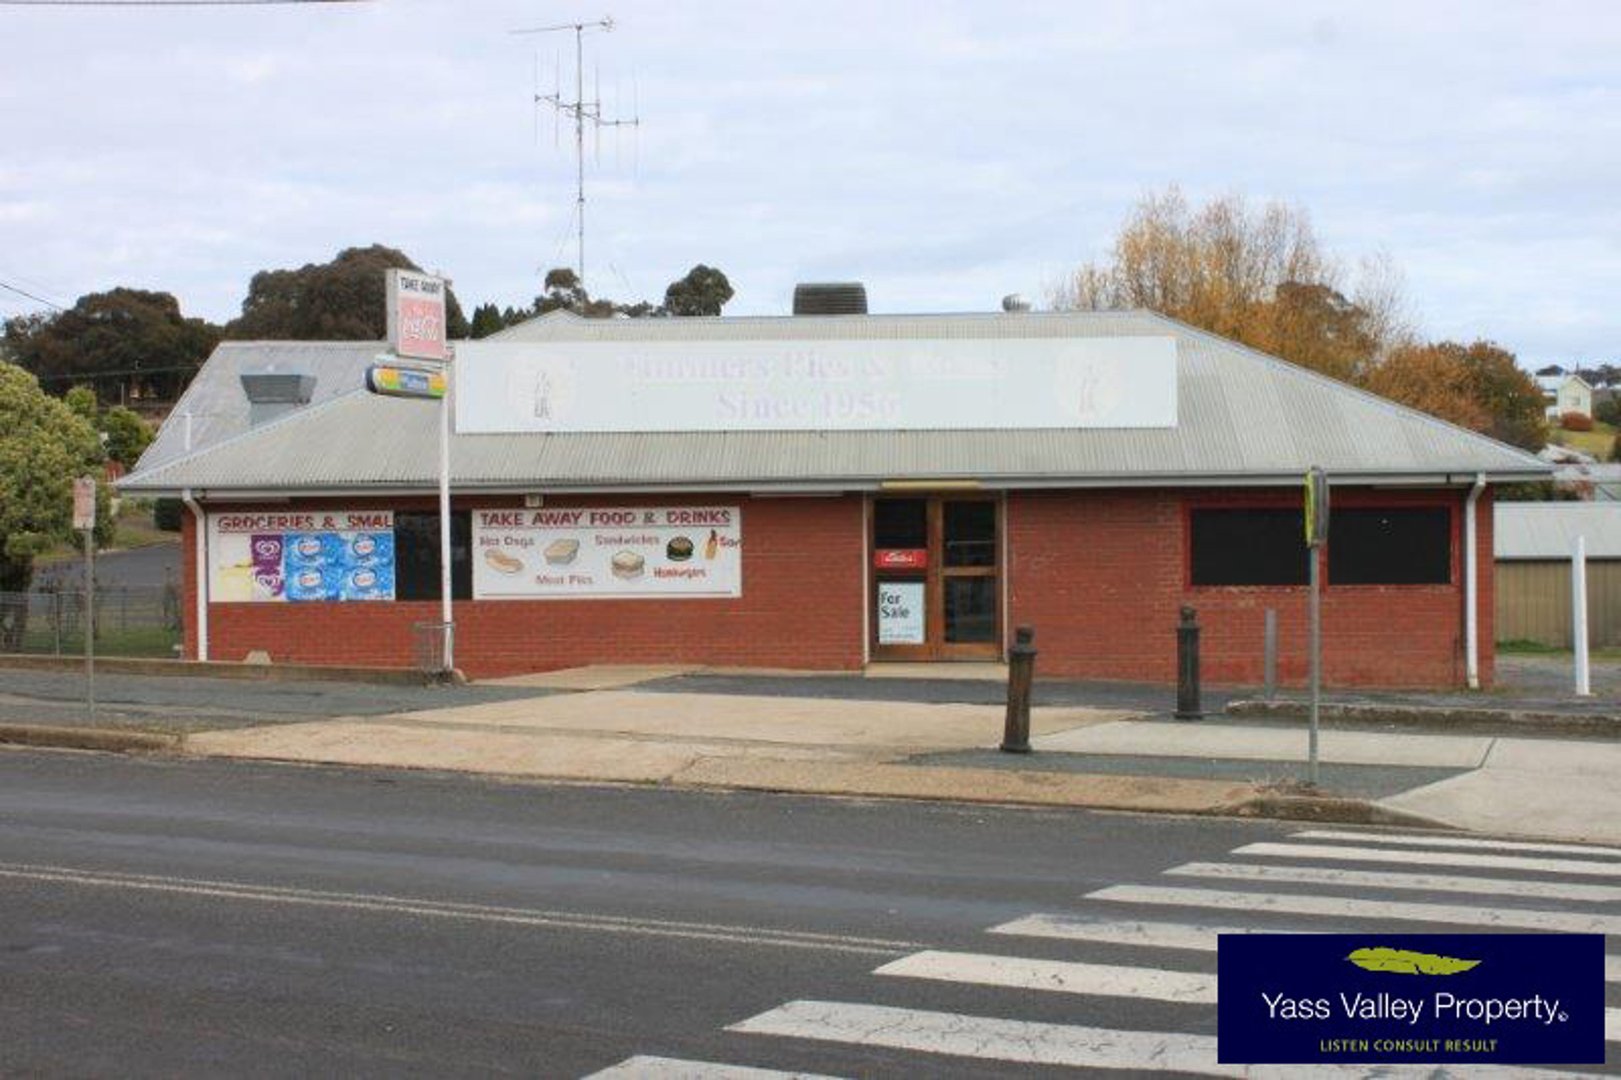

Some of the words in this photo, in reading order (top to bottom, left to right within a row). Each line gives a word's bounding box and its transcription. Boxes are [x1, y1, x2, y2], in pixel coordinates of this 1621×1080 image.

[218, 515, 314, 530] GROCERIES
[321, 515, 336, 529] &
[480, 512, 524, 526] TAKE
[532, 511, 582, 526] AWAY
[589, 511, 636, 525] FOOD
[643, 511, 656, 524] &
[666, 510, 731, 524] DRINKS
[880, 591, 901, 604] For
[880, 605, 910, 618] Sale
